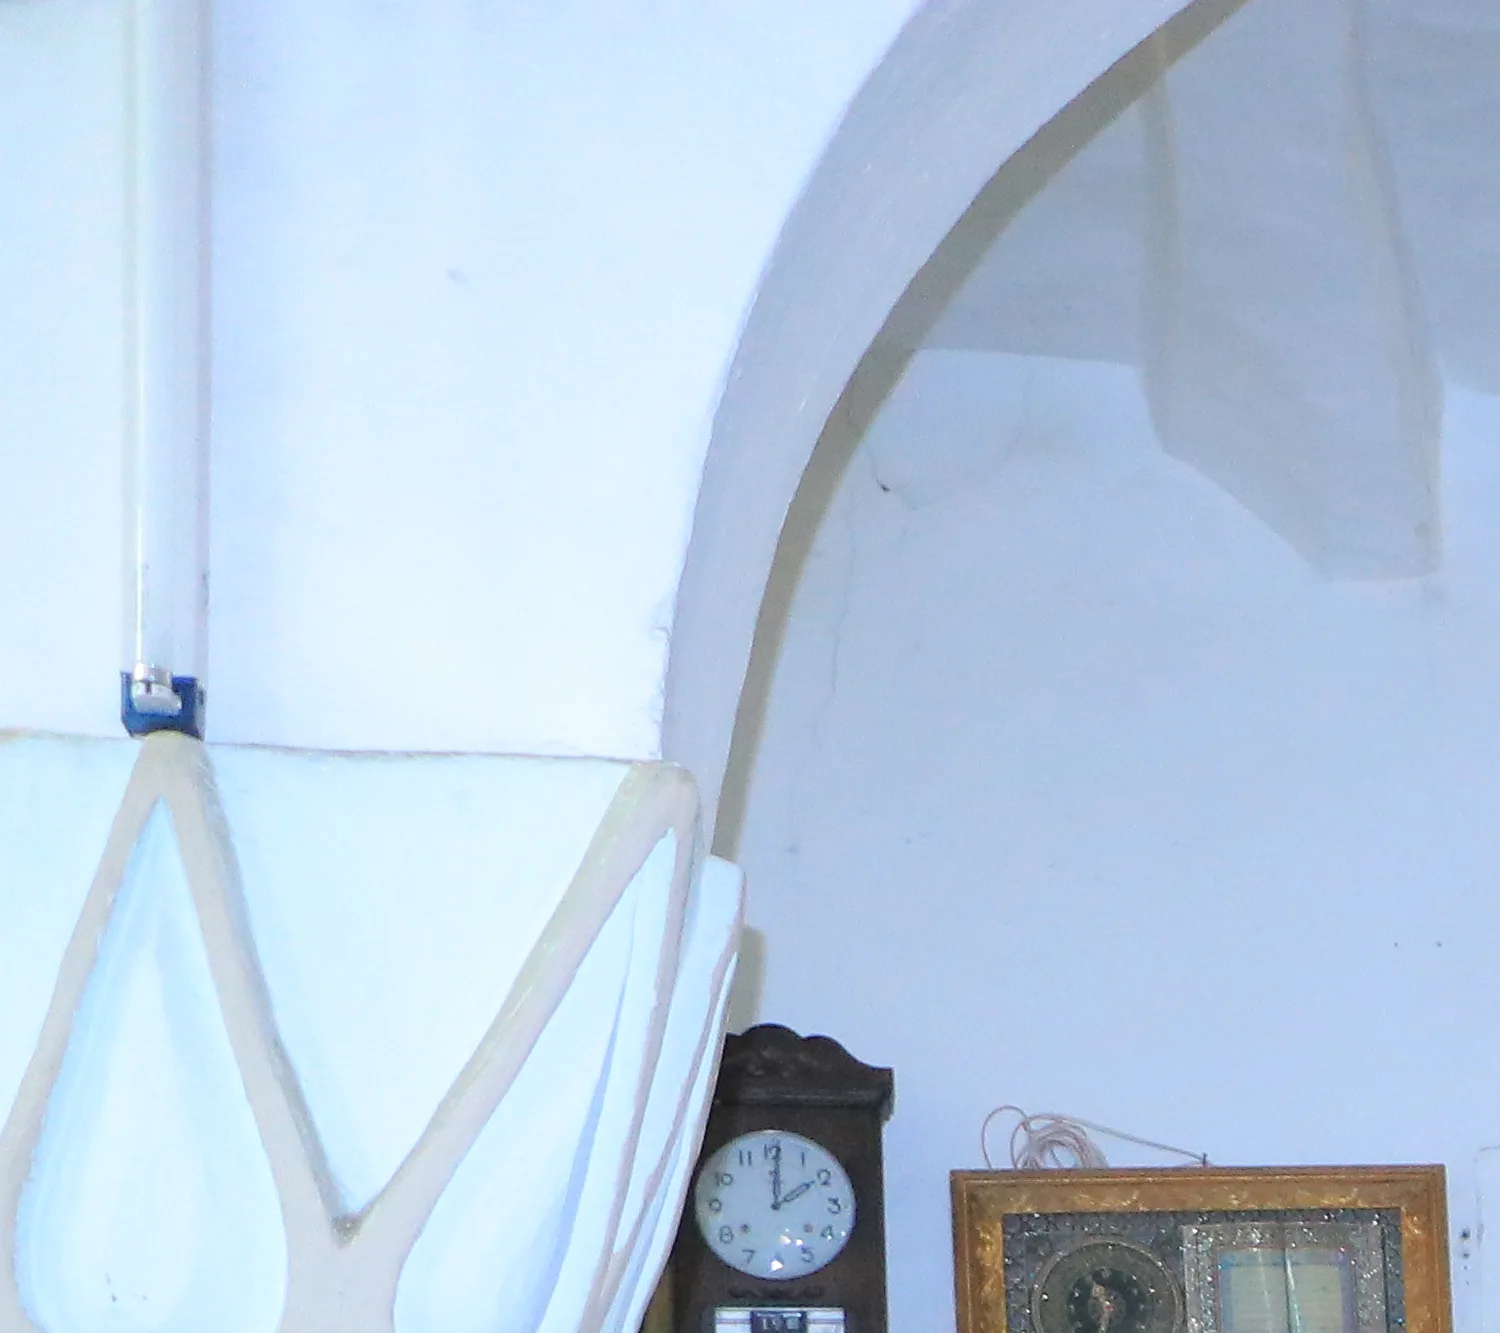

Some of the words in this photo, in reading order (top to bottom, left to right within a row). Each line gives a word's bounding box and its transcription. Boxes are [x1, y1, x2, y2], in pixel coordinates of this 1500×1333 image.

[816, 1168, 832, 1187] 2
[709, 1199, 722, 1214] 9
[827, 1197, 842, 1215] 3
[718, 1225, 734, 1245] 8
[820, 1224, 835, 1240] 4
[741, 1249, 756, 1265] 7
[800, 1245, 814, 1263] 5
